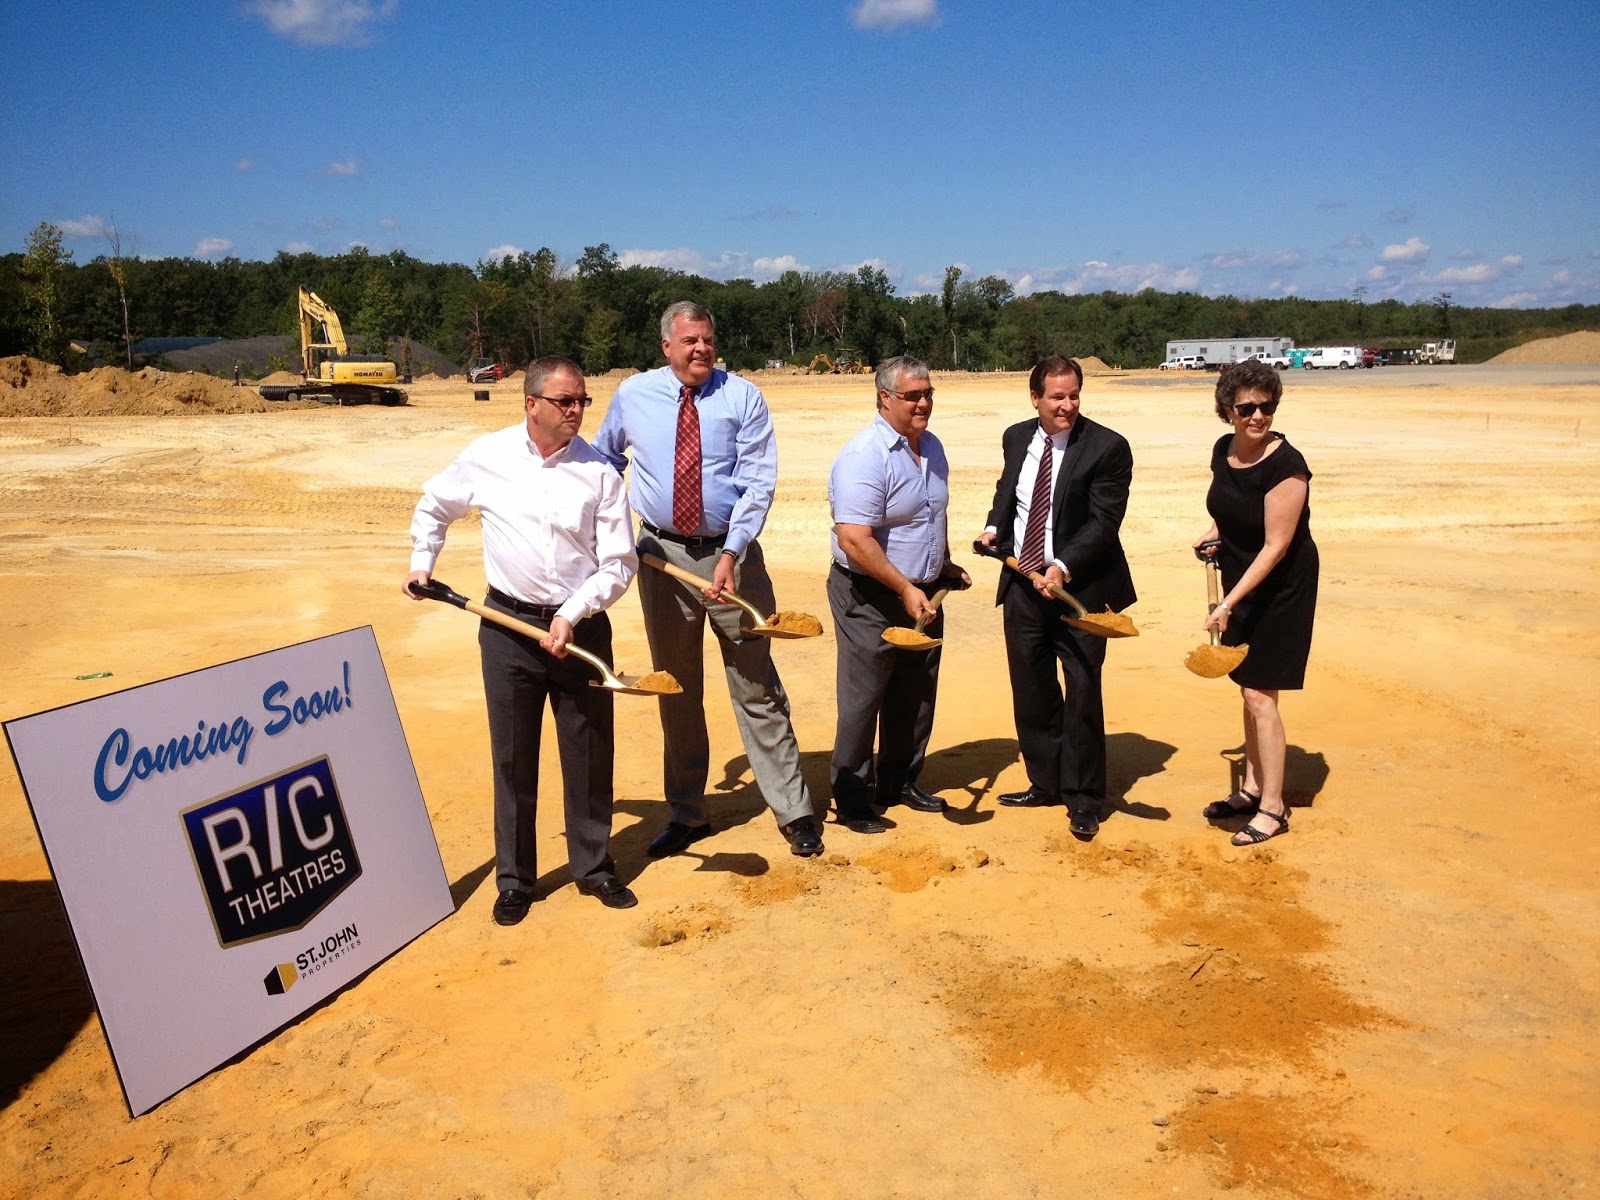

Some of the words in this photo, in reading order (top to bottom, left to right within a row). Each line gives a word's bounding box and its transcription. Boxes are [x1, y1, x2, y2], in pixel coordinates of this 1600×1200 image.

[94, 716, 254, 802] Coming
[263, 661, 351, 736] Soon!
[202, 775, 334, 893] R/C
[229, 849, 346, 925] THEATRES
[302, 939, 361, 979] PROPERTIES
